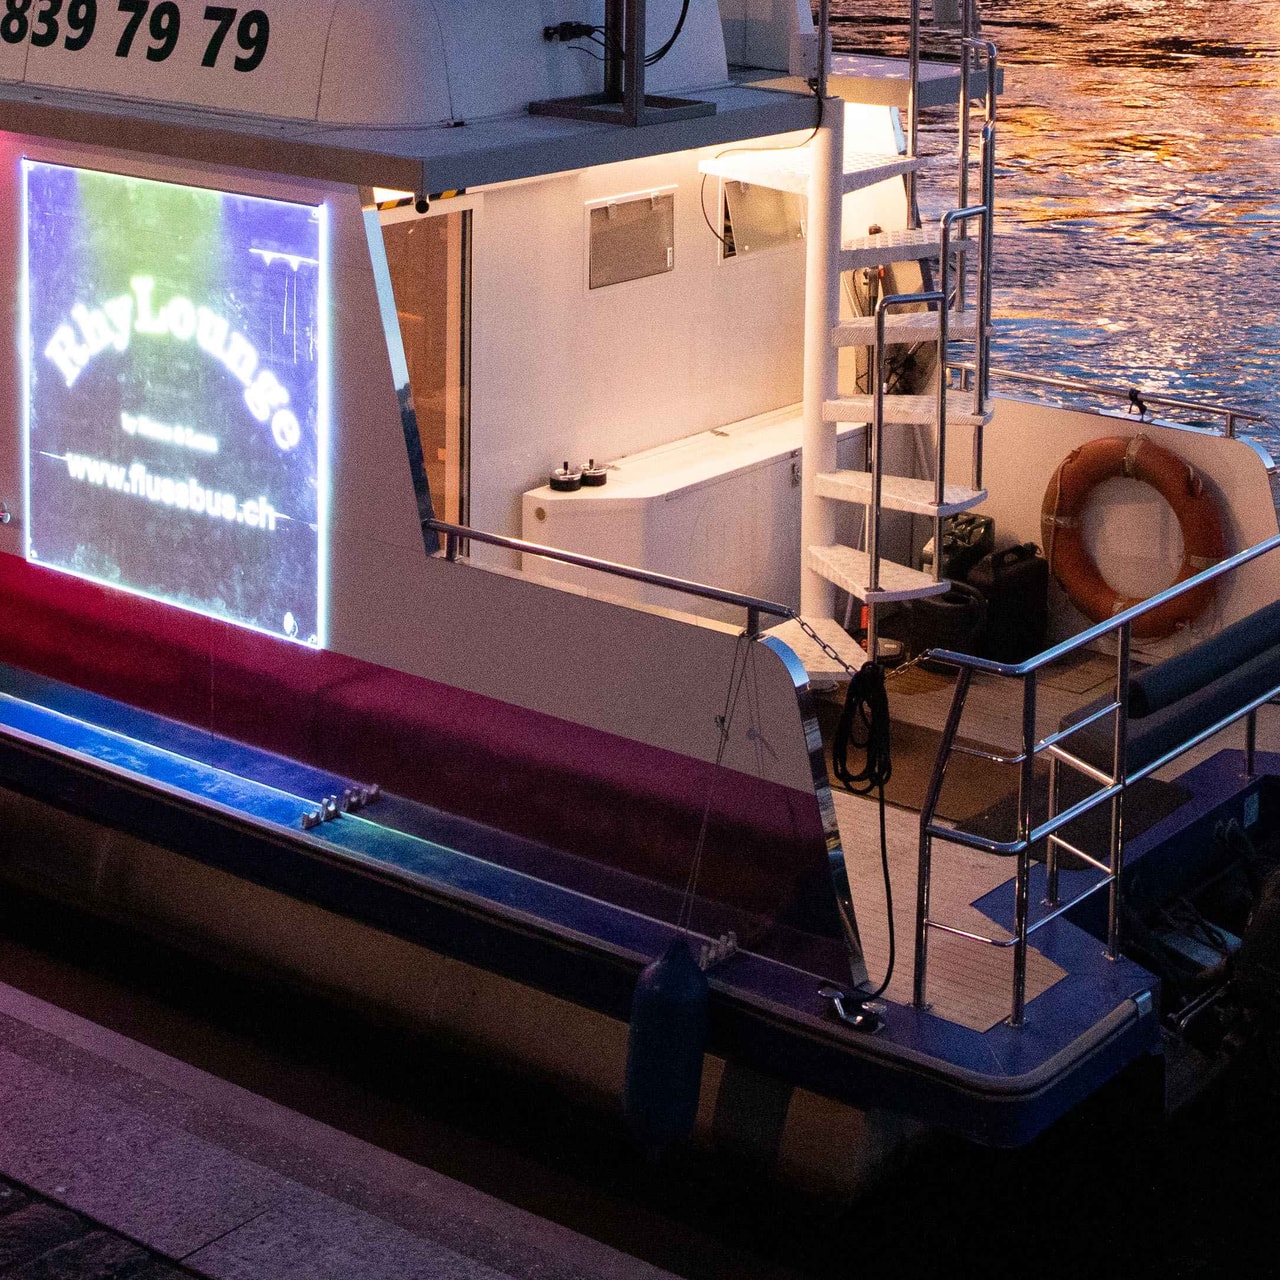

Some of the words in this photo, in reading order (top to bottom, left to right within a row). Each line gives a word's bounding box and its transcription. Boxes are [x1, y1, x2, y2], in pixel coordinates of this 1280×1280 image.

[201, 5, 270, 73] 79
[45, 276, 301, 451] RhyLounge
[66, 452, 277, 531] www.flussbus.ch
